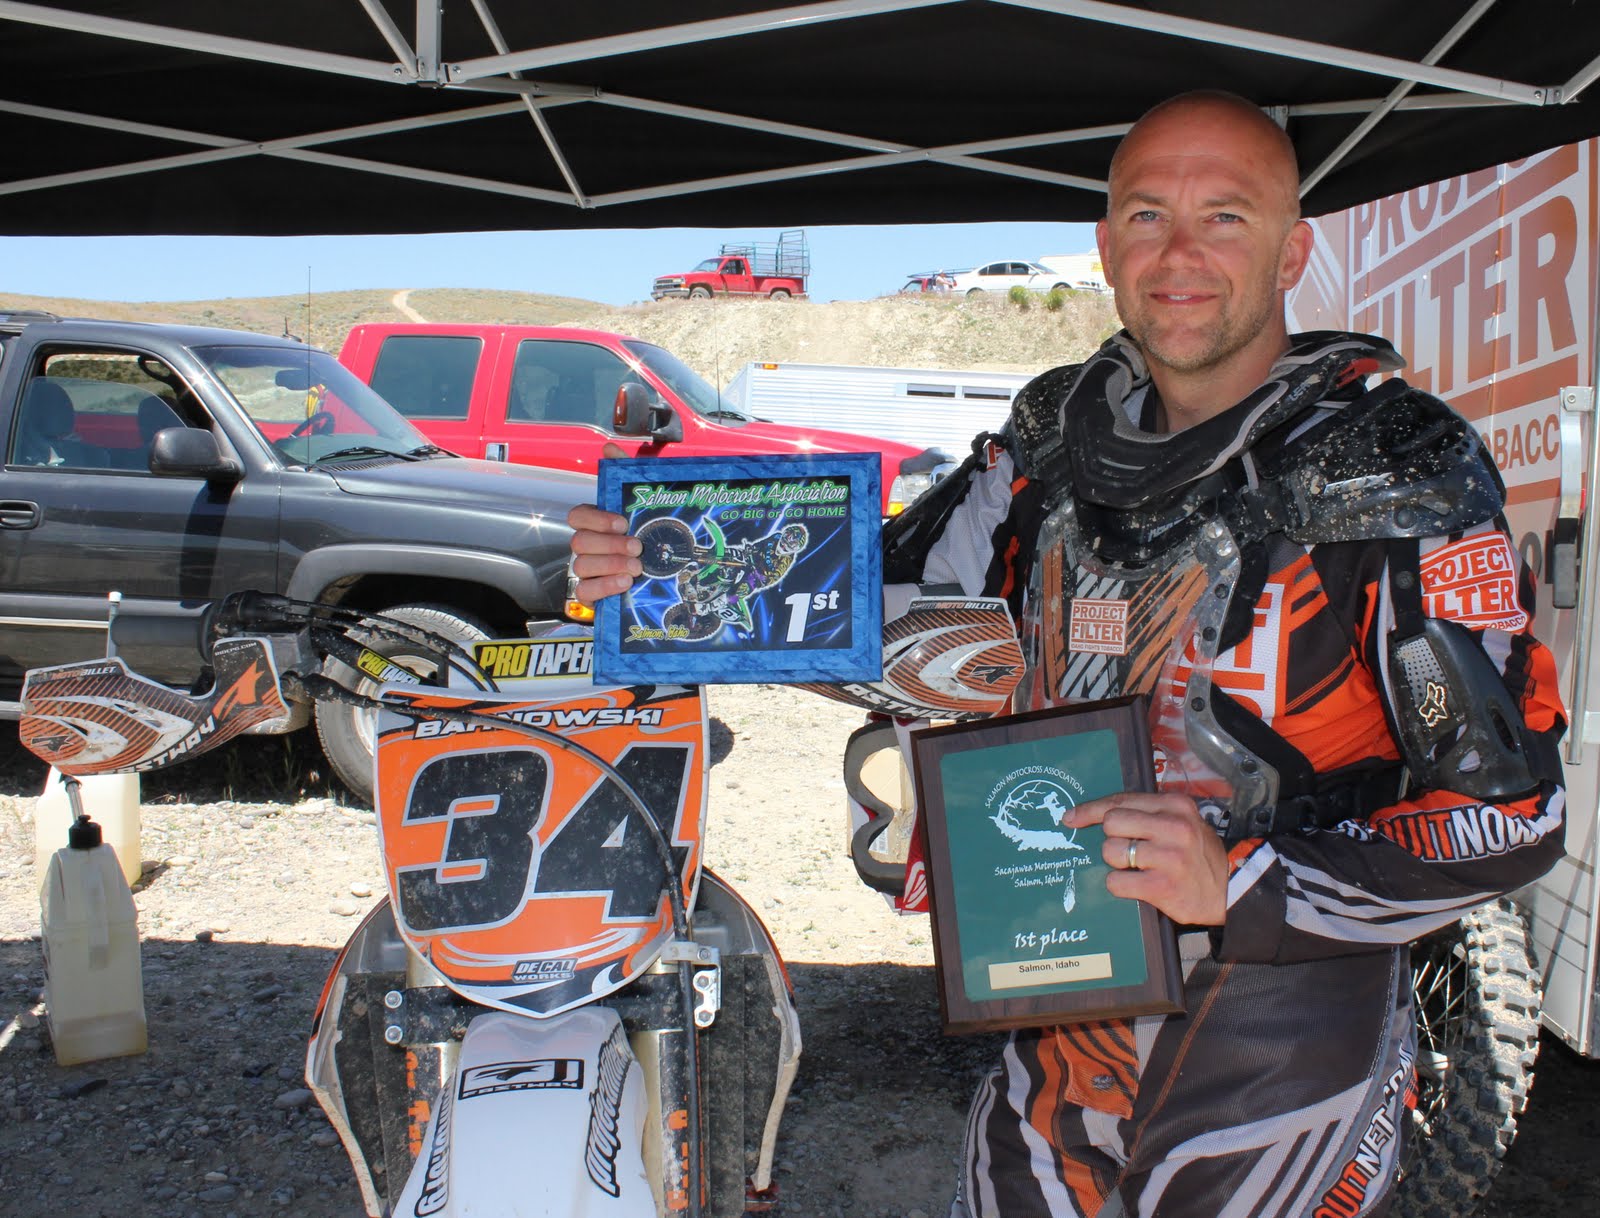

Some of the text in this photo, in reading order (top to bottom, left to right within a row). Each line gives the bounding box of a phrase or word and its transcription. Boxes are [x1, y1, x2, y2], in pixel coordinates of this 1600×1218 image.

[1353, 195, 1578, 402] ILTER
[1482, 413, 1560, 471] BACC
[627, 480, 848, 512] Salmon Motocross Association
[720, 510, 736, 520] GO
[743, 509, 765, 519] BIG
[784, 508, 804, 518] GO
[807, 506, 846, 517] HOME
[1422, 579, 1516, 618] ILTER
[784, 590, 840, 642] 1st
[1073, 605, 1125, 620] PROJECT
[1071, 622, 1124, 641] FILTER
[985, 765, 1085, 808] SALMON MOTOCROSS ASSOCIATION
[395, 742, 697, 936] 34
[994, 855, 1092, 880] Sacajawea Motorsports Park
[1014, 872, 1065, 888] Salmon, Idaho
[1013, 926, 1089, 956] 1st place
[513, 972, 572, 981] WORKS
[516, 960, 575, 974] DECAL
[1018, 959, 1081, 974] Salmon, Idaho
